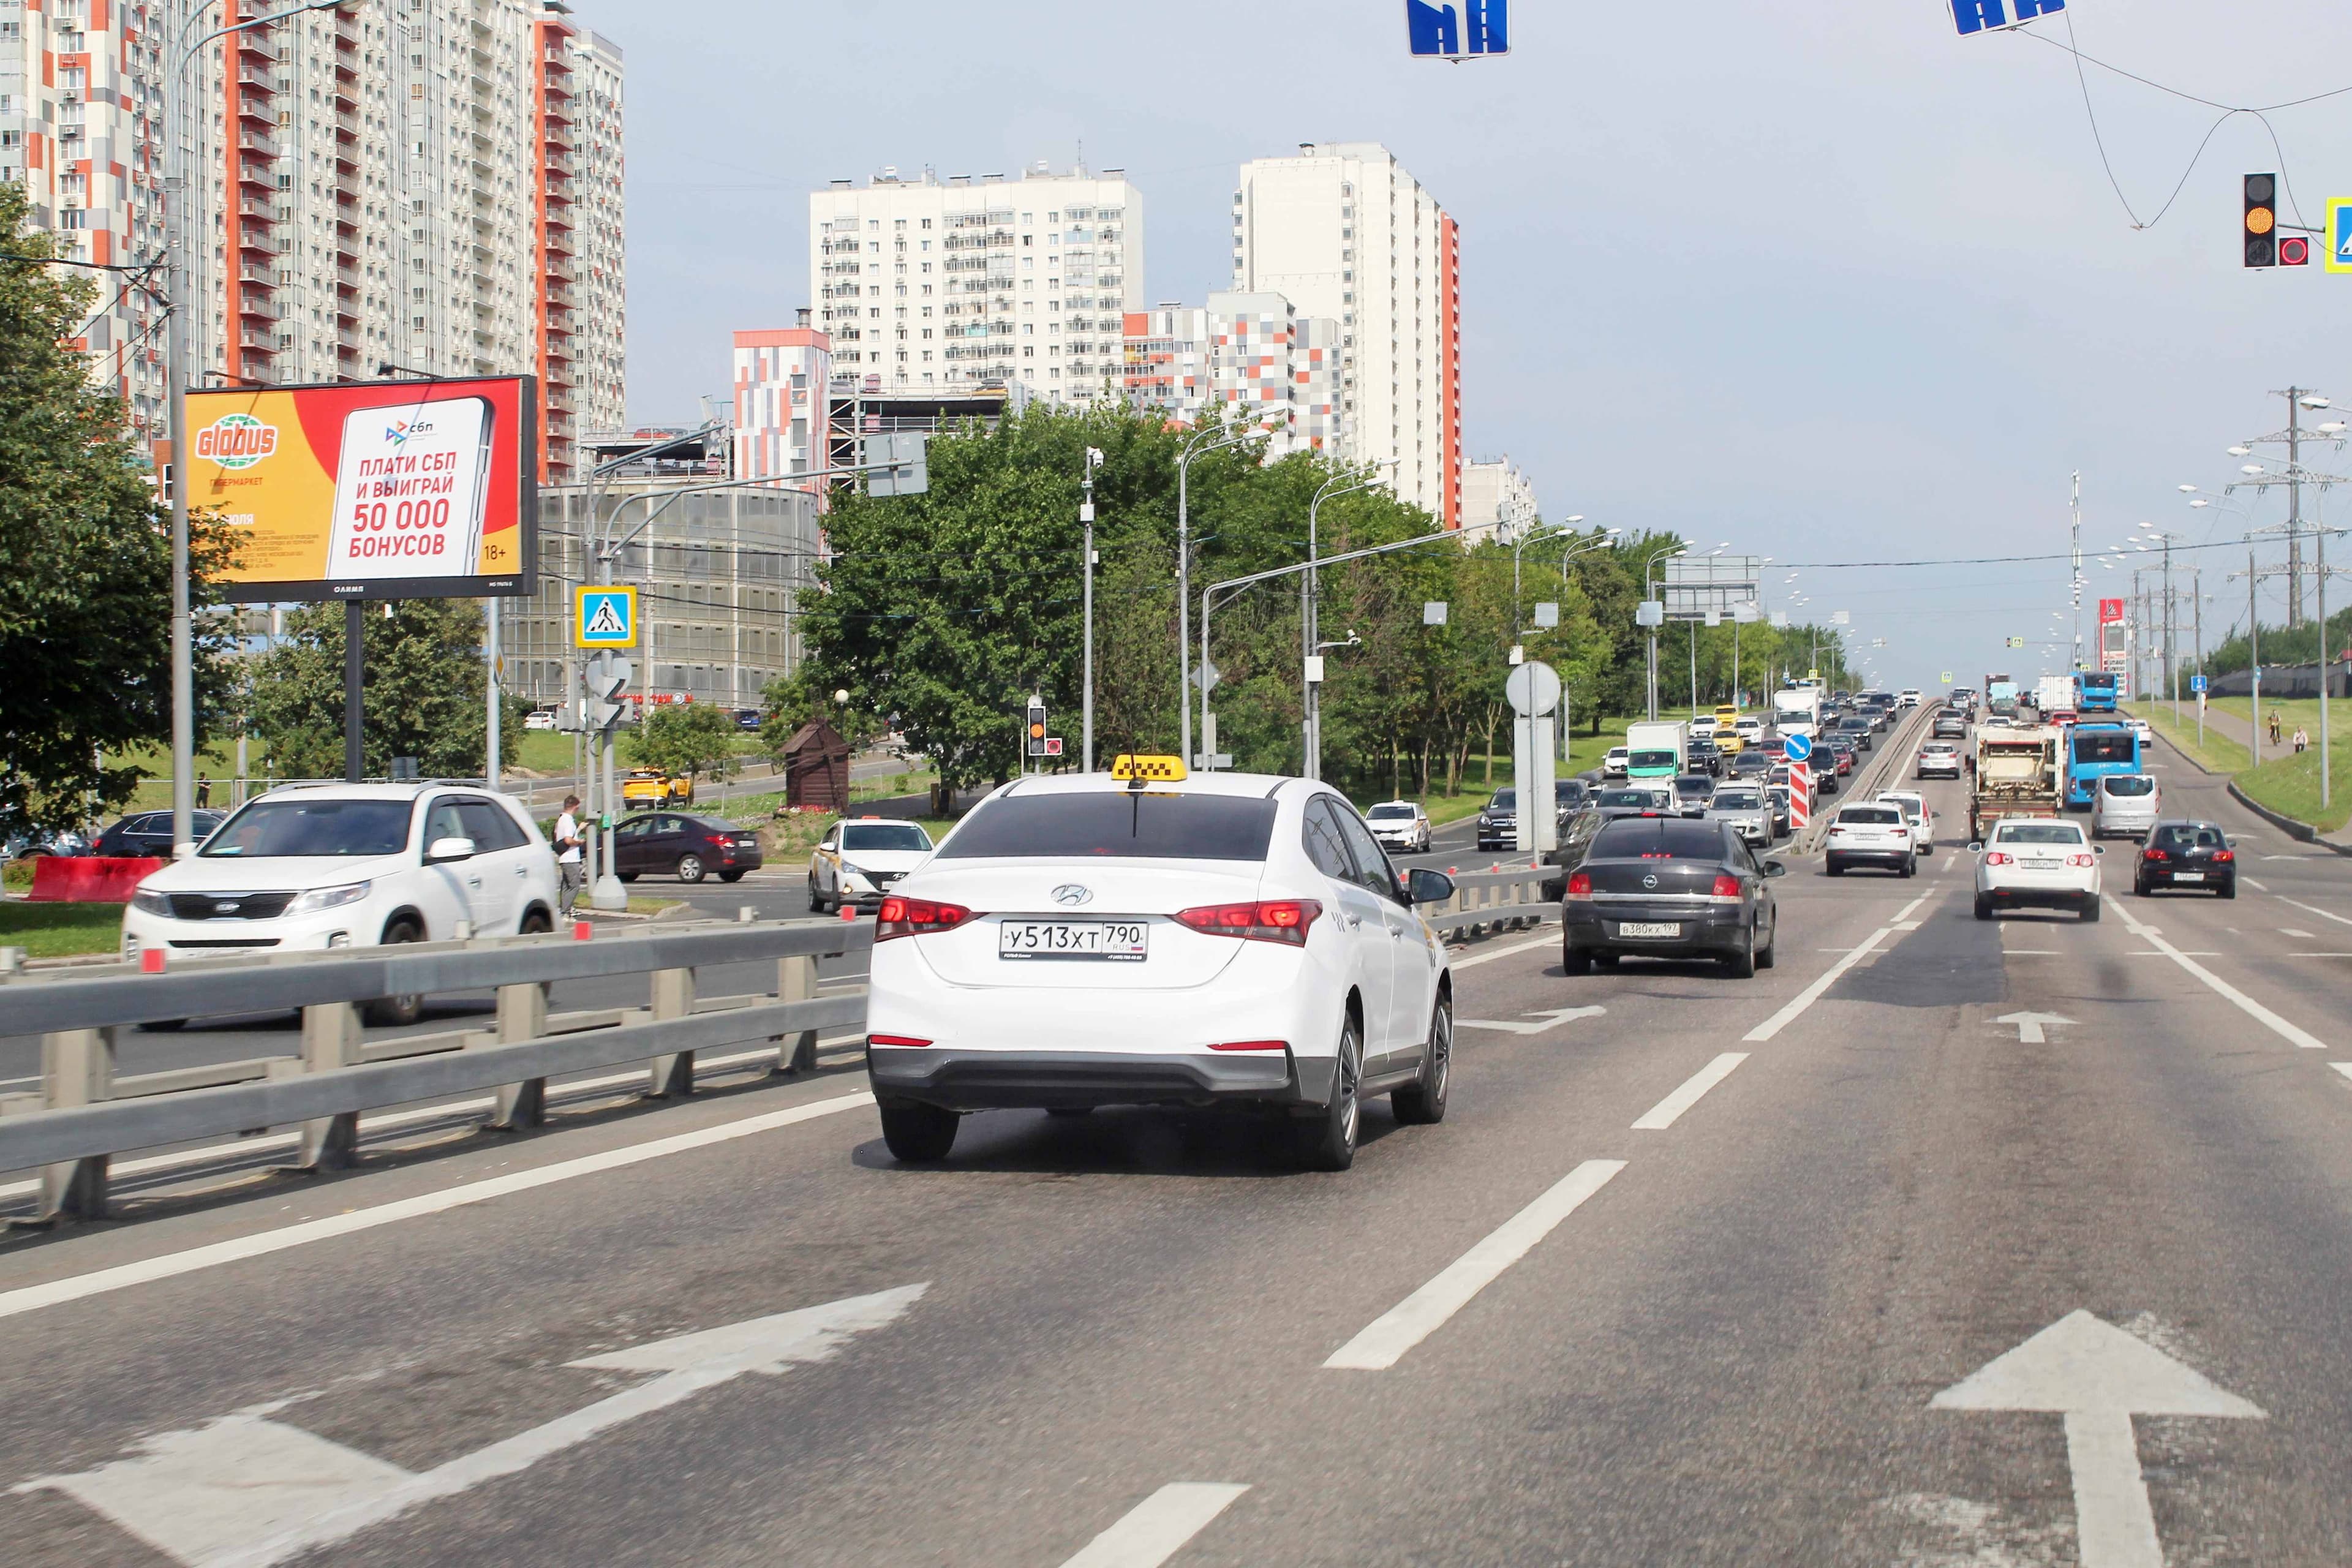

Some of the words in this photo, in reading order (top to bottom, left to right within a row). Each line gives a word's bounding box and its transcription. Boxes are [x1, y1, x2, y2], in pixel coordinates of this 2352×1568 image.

[198, 423, 275, 456] Globus
[359, 456, 417, 477] ПЛАТИ
[421, 451, 457, 472] СБП
[356, 483, 368, 499] И
[373, 472, 453, 498] ВЫИГРАЙ
[353, 502, 387, 532] 50
[396, 498, 450, 530] 000
[349, 533, 445, 558] БОНУСОВ
[484, 545, 506, 560] 18+
[1106, 925, 1140, 943] 790
